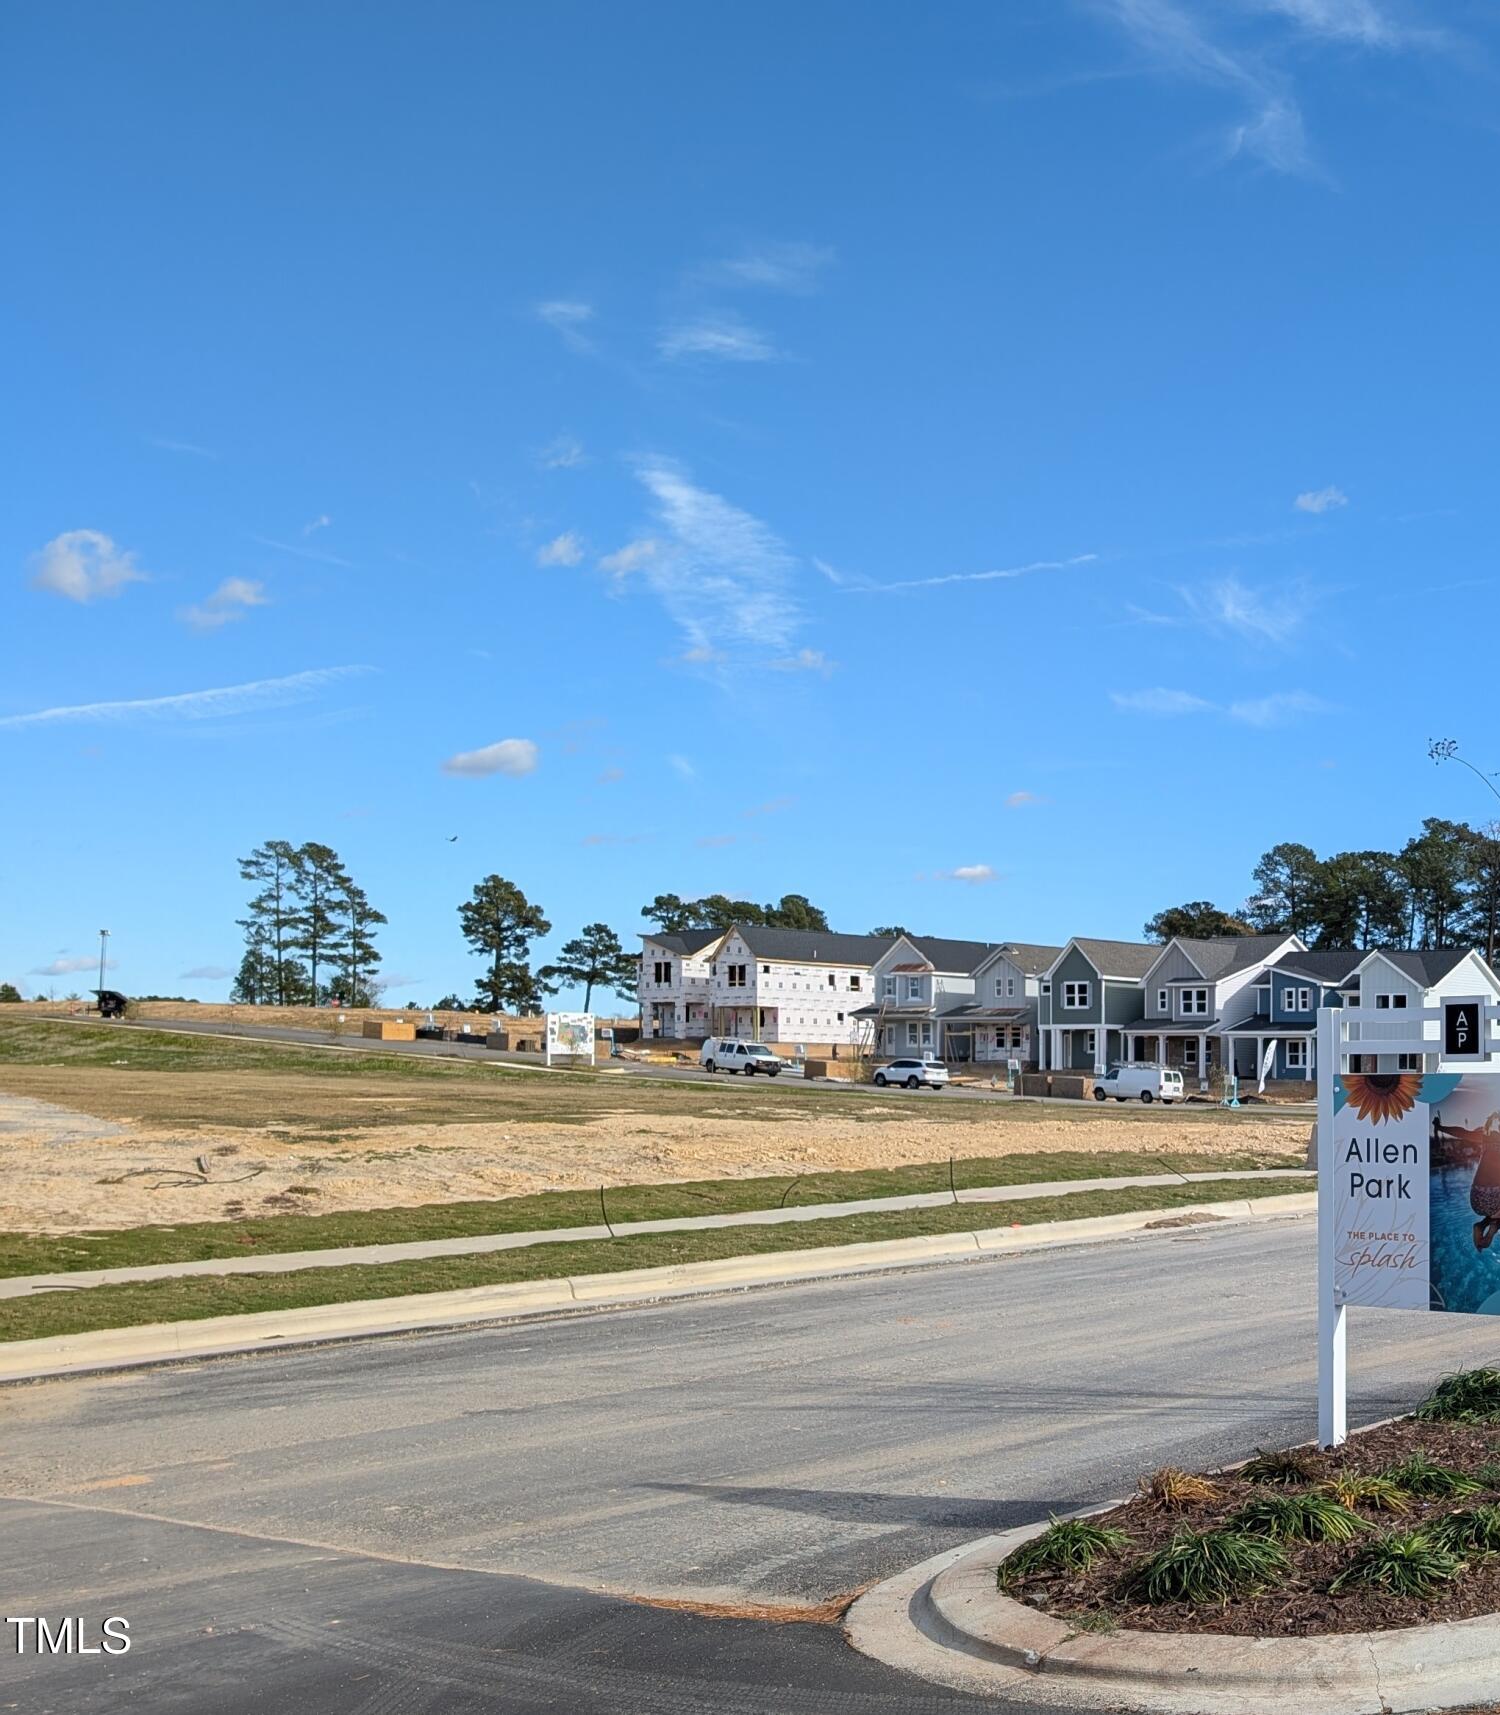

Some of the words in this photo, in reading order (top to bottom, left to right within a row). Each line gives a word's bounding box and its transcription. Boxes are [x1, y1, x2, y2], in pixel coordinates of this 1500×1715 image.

[1456, 1010, 1468, 1026] A
[1458, 1032, 1467, 1048] P
[1345, 1137, 1418, 1164] Allen
[1350, 1172, 1411, 1199] Park
[1347, 1231, 1366, 1240] THE
[1368, 1231, 1399, 1241] PLACE
[1402, 1233, 1416, 1242] TO
[1341, 1242, 1423, 1279] splash
